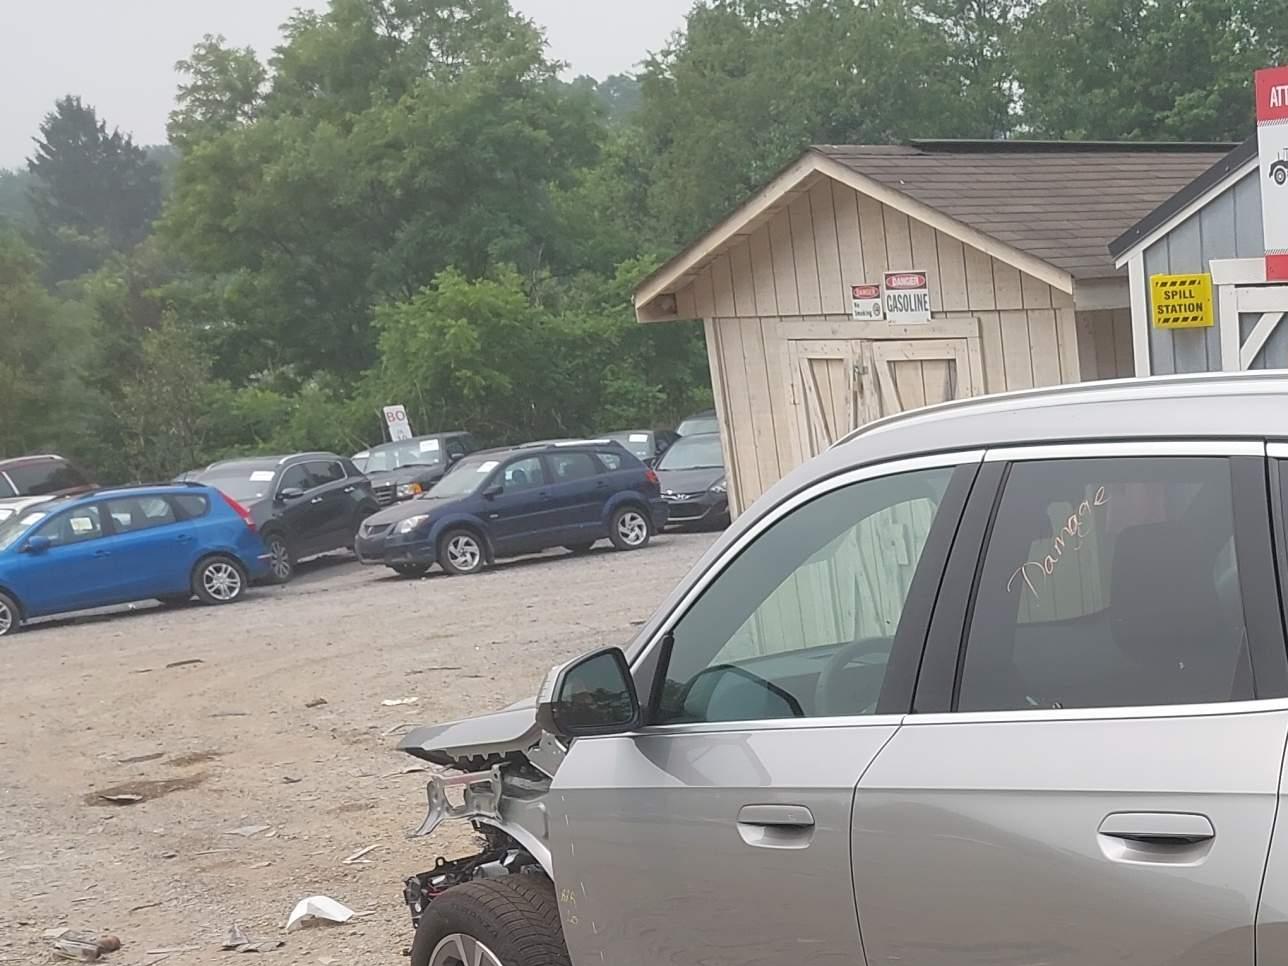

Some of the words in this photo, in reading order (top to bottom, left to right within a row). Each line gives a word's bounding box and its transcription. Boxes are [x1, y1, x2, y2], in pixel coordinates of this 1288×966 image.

[1163, 289, 1195, 300] SPILL
[886, 293, 929, 313] GASOLINE
[1157, 302, 1203, 314] STATION
